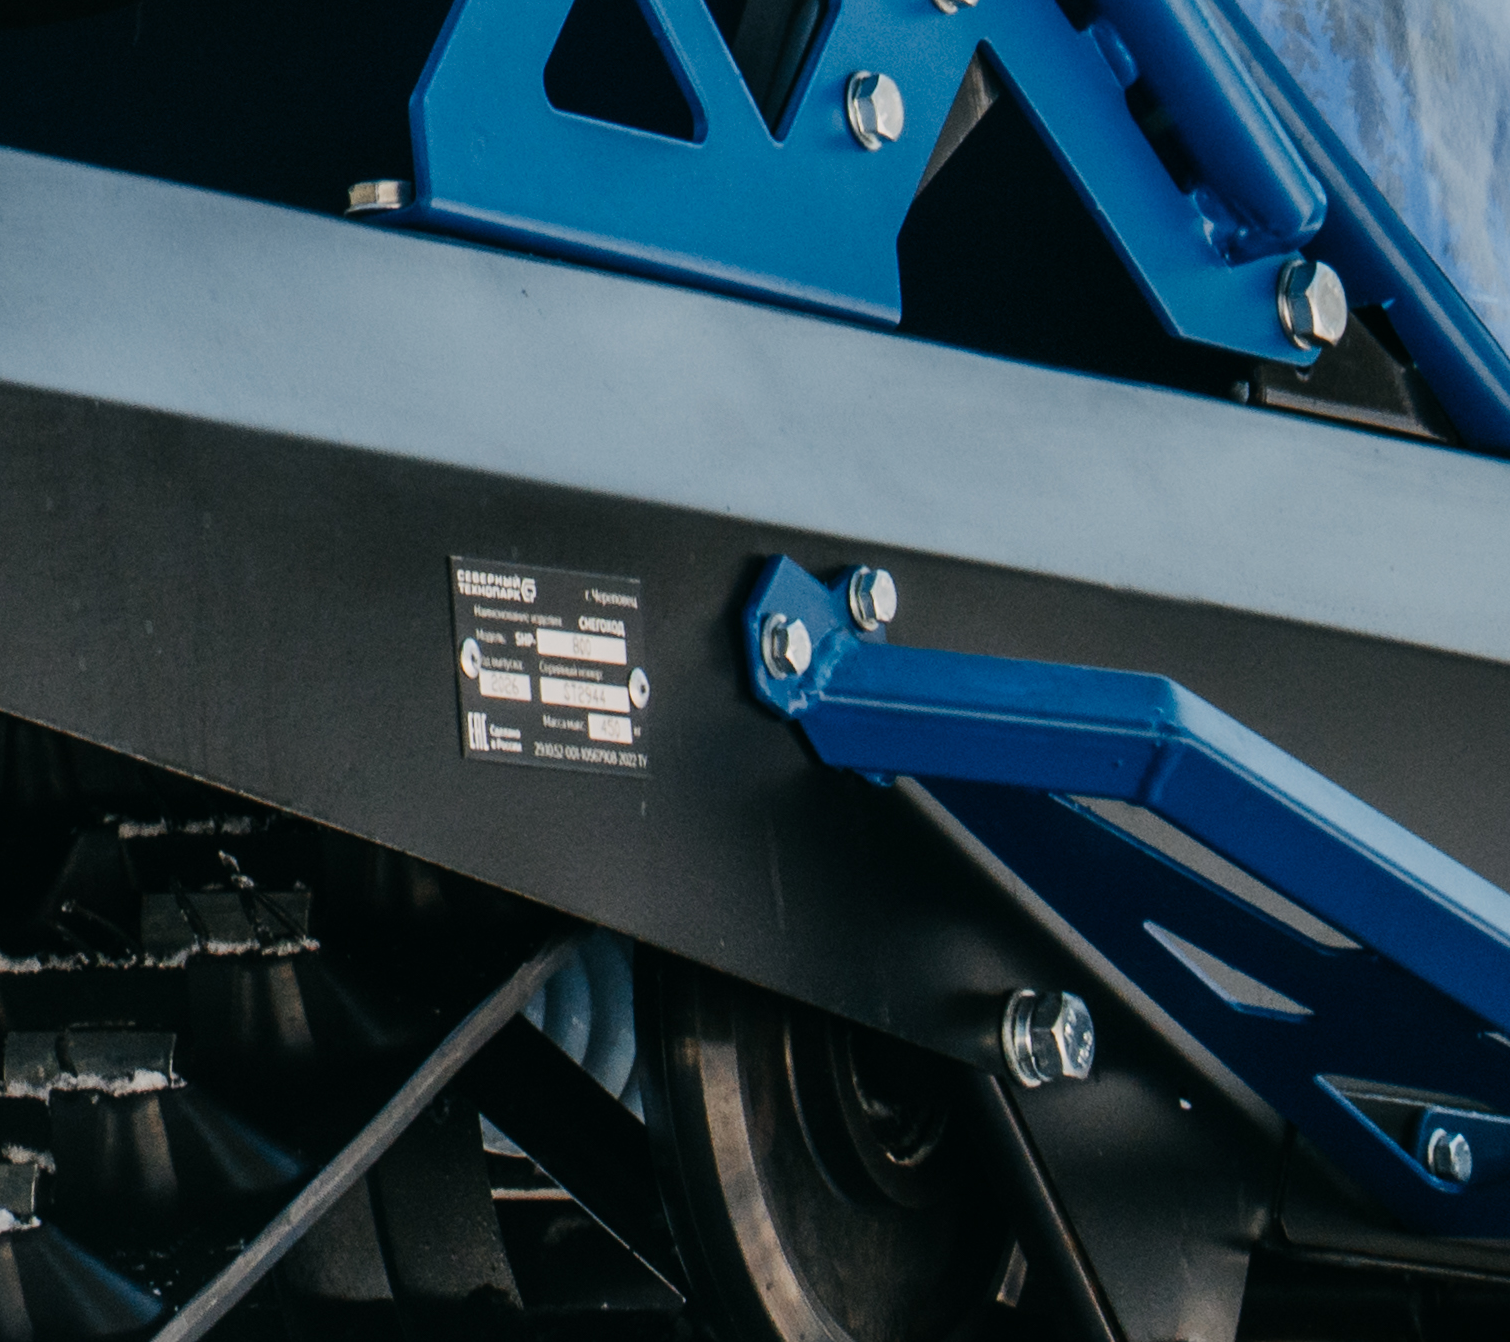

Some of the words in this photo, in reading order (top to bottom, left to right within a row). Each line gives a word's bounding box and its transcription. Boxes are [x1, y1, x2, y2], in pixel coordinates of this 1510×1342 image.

[457, 569, 521, 589] СЕВЕРНЫЙ
[458, 582, 521, 602] ТЕХНОПАРК
[578, 615, 626, 638] СНЕГОХОД
[572, 634, 591, 656] 800
[491, 674, 520, 695] 2026
